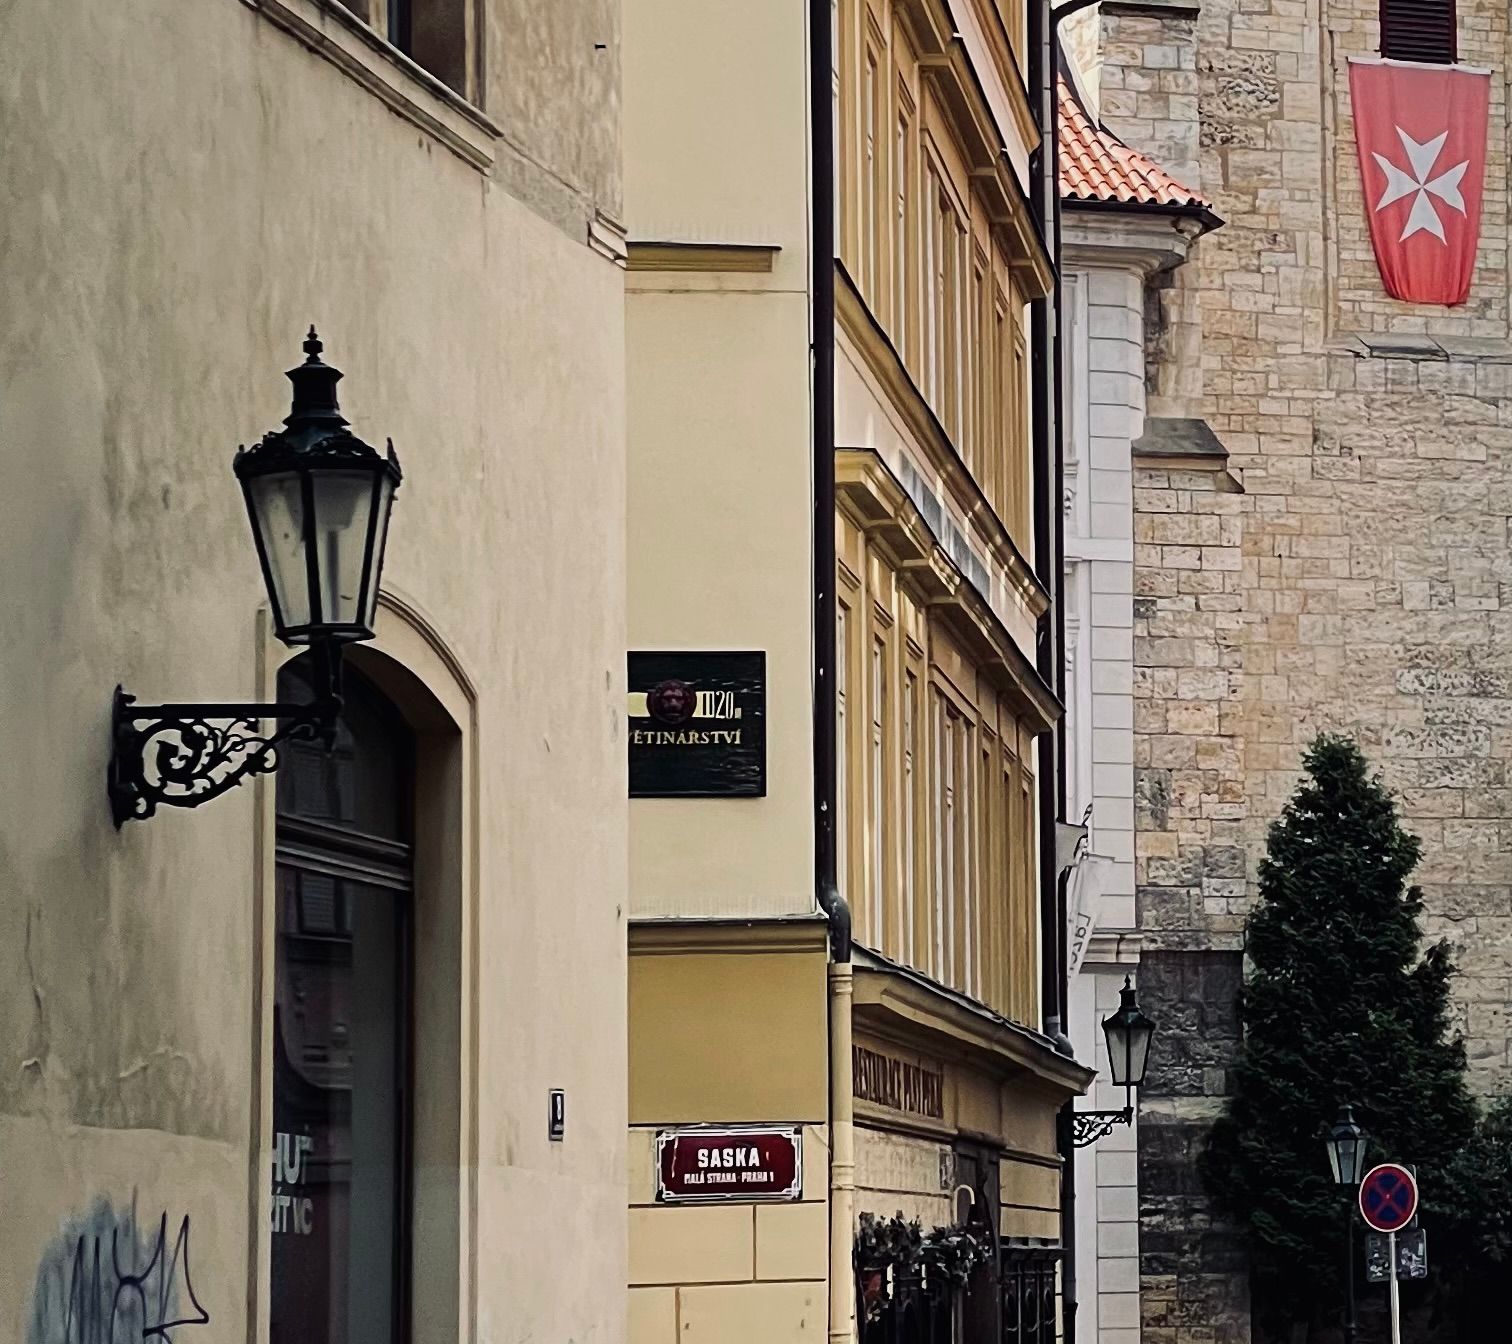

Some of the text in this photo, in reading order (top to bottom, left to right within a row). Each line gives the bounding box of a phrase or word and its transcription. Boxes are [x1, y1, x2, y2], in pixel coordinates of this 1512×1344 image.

[684, 1170, 705, 1185] MALÁ
[706, 1172, 737, 1184] STRANA
[741, 1171, 767, 1183] PRAHA
[769, 1171, 774, 1183] 1
